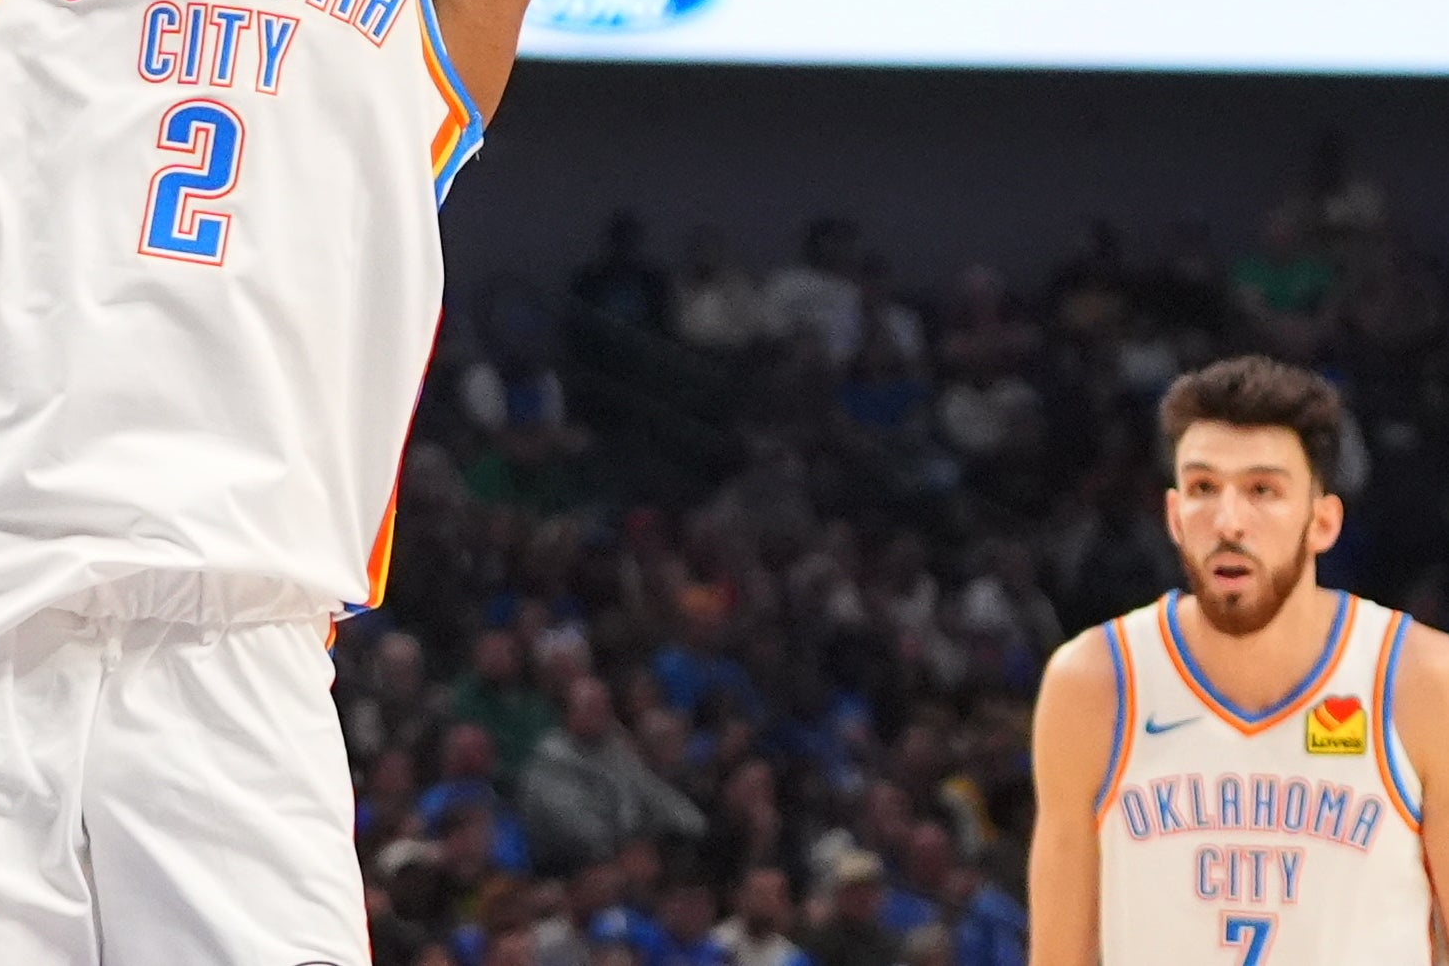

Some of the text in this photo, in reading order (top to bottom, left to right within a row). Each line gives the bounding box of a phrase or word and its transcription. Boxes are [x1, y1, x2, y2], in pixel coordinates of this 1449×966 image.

[138, 1, 299, 95] CITY
[138, 98, 245, 266] 2
[1121, 772, 1387, 853] OKLAHOMA
[1194, 843, 1306, 903] CITY
[1219, 909, 1280, 966] 7
